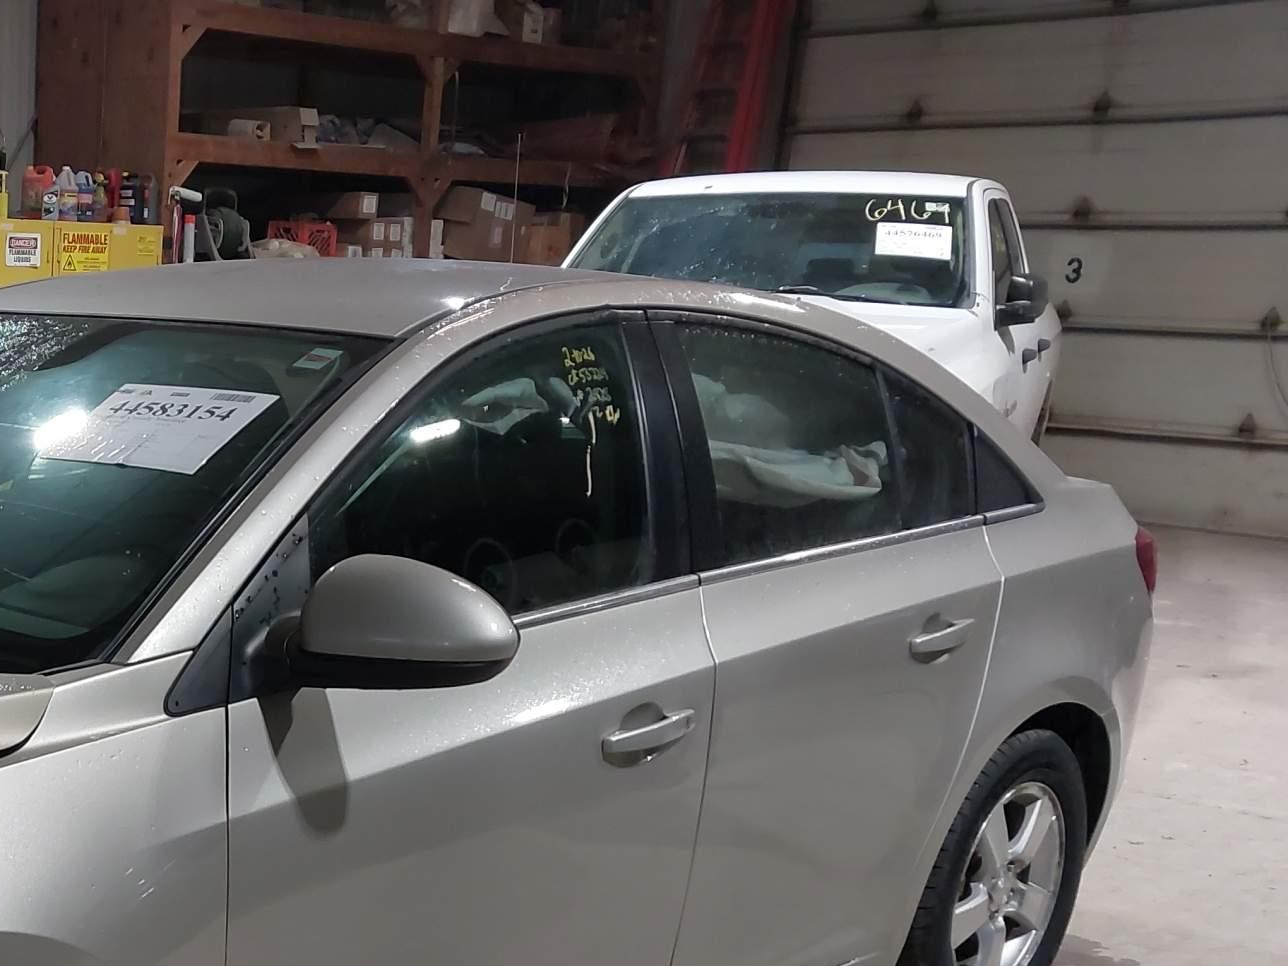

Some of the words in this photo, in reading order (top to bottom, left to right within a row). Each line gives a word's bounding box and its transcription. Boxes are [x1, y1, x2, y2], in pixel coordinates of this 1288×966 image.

[12, 239, 34, 247] DANGER
[63, 233, 108, 245] FLAMMABLE
[63, 245, 77, 254] KEEP
[78, 246, 91, 254] FIRE
[1065, 257, 1083, 284] 3
[109, 400, 239, 421] 44583154
